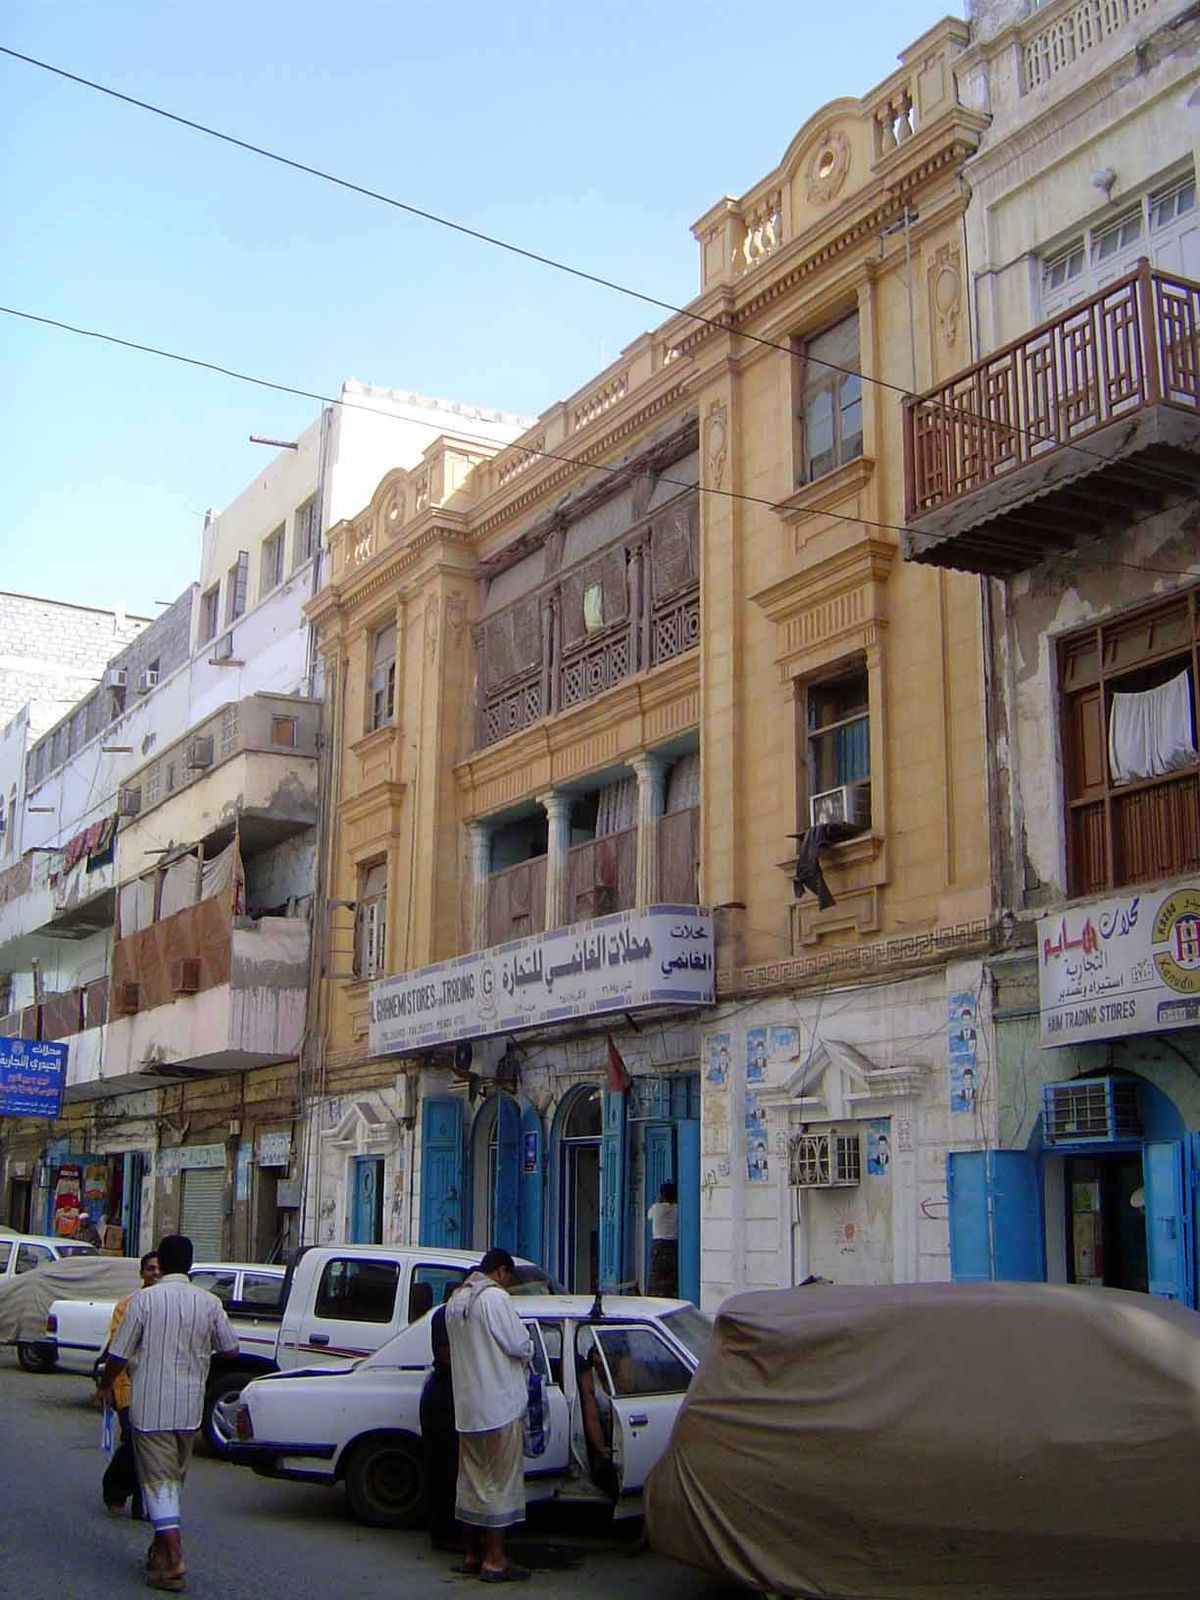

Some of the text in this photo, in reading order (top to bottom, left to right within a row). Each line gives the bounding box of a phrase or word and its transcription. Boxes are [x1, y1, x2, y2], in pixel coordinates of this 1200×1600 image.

[670, 924, 708, 939] محلات
[1043, 897, 1139, 965] محلات هايم
[502, 926, 652, 996] محلات الغانمي للتجارة
[661, 951, 712, 979] الغانمي
[1066, 949, 1108, 981] التجارية
[407, 984, 435, 1015] STORES
[442, 974, 475, 1004] TRADING
[1088, 975, 1124, 995] استيراد
[1064, 1006, 1097, 1029] TRADING
[1099, 999, 1136, 1023] STORES
[32, 1044, 62, 1056] محلات
